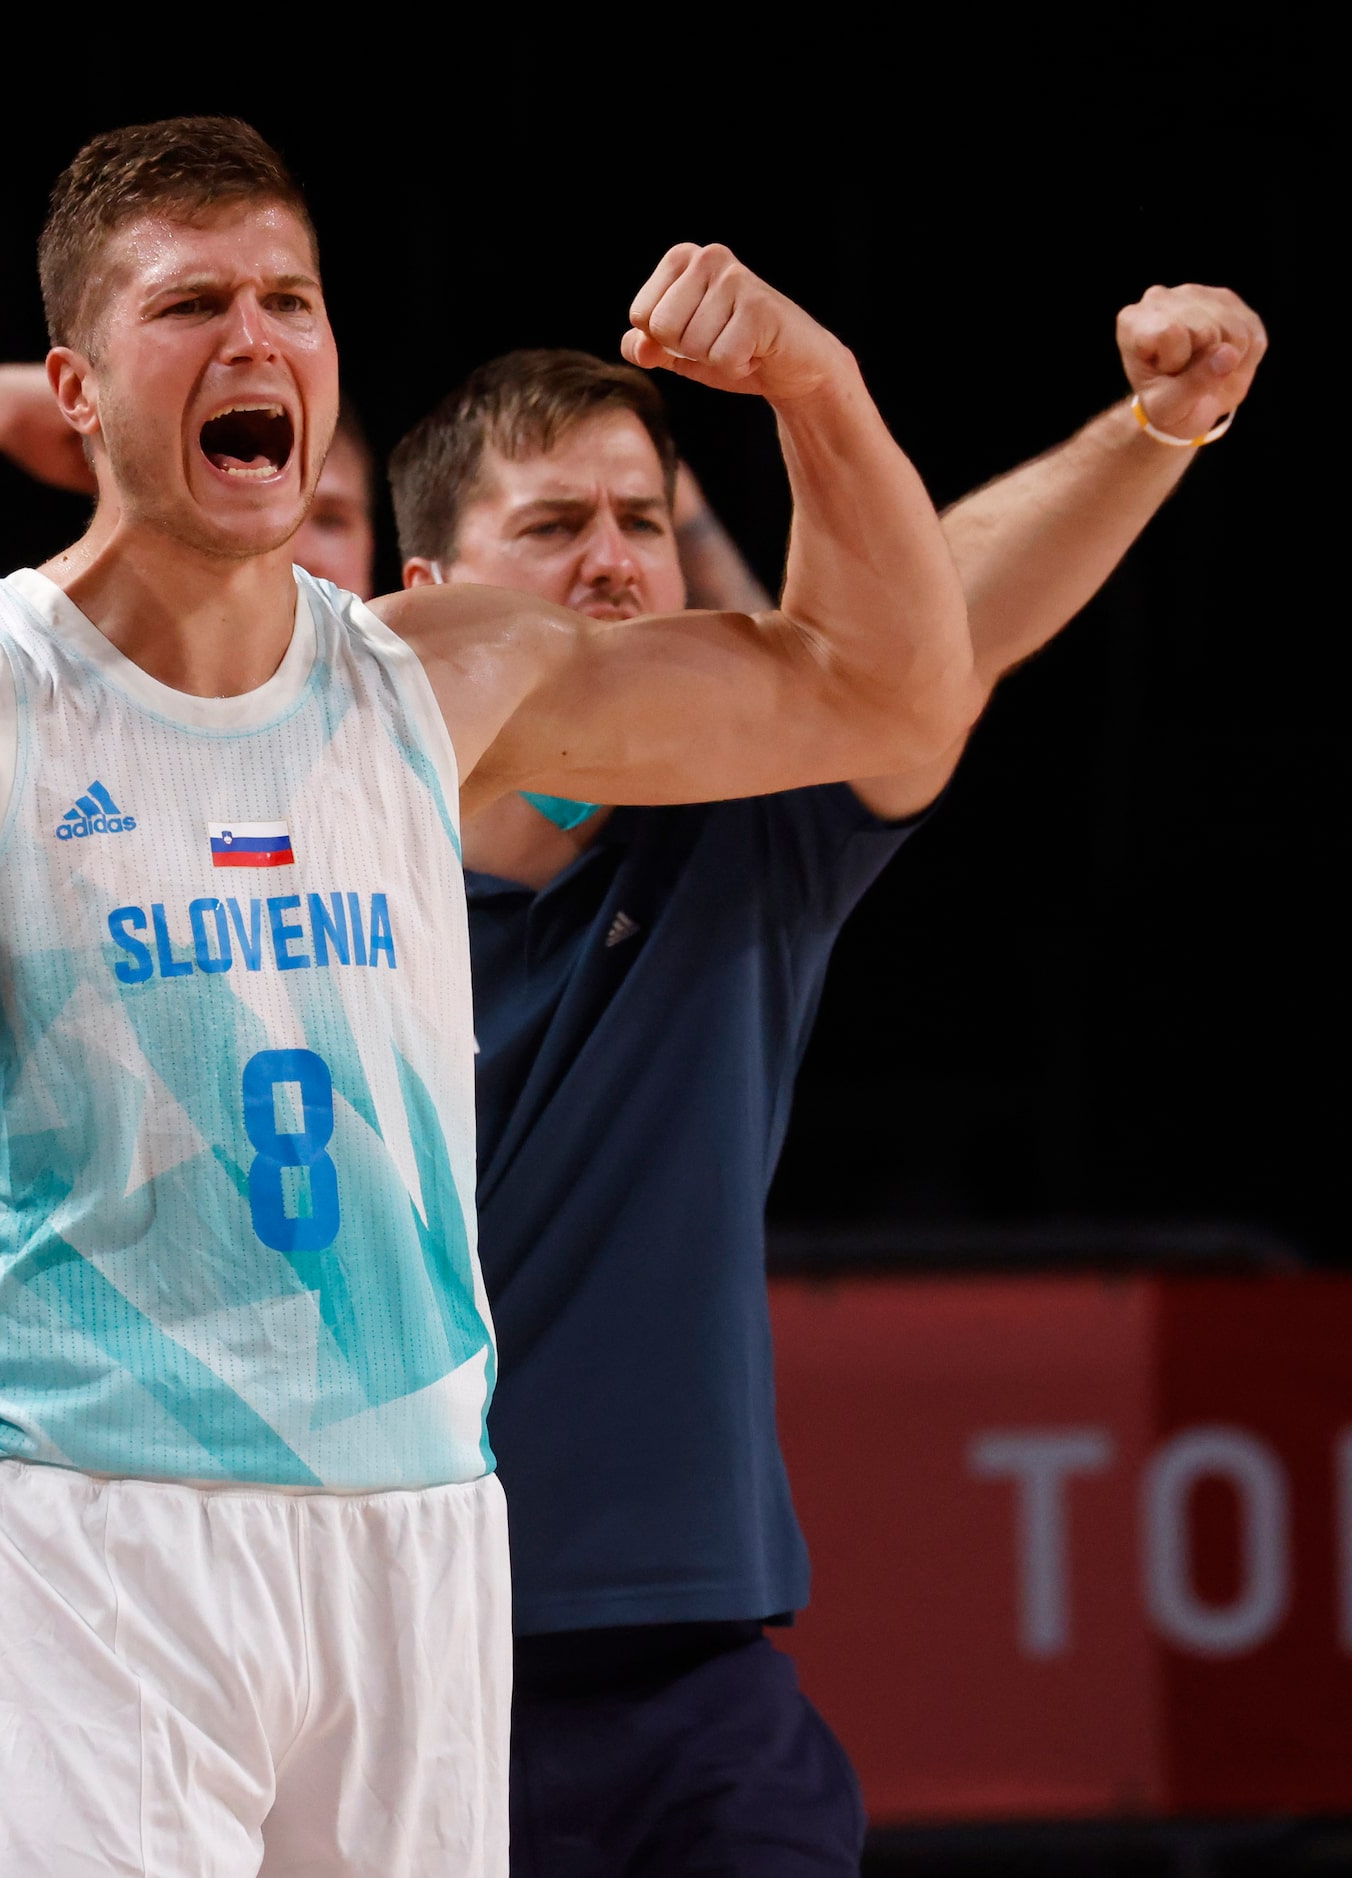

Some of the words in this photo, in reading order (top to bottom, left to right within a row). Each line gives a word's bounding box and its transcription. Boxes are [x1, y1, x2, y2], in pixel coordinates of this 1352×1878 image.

[56, 811, 137, 841] adidas
[107, 891, 398, 985] SLOVENIA
[241, 1047, 341, 1253] 8
[969, 1426, 1352, 1660] TO
